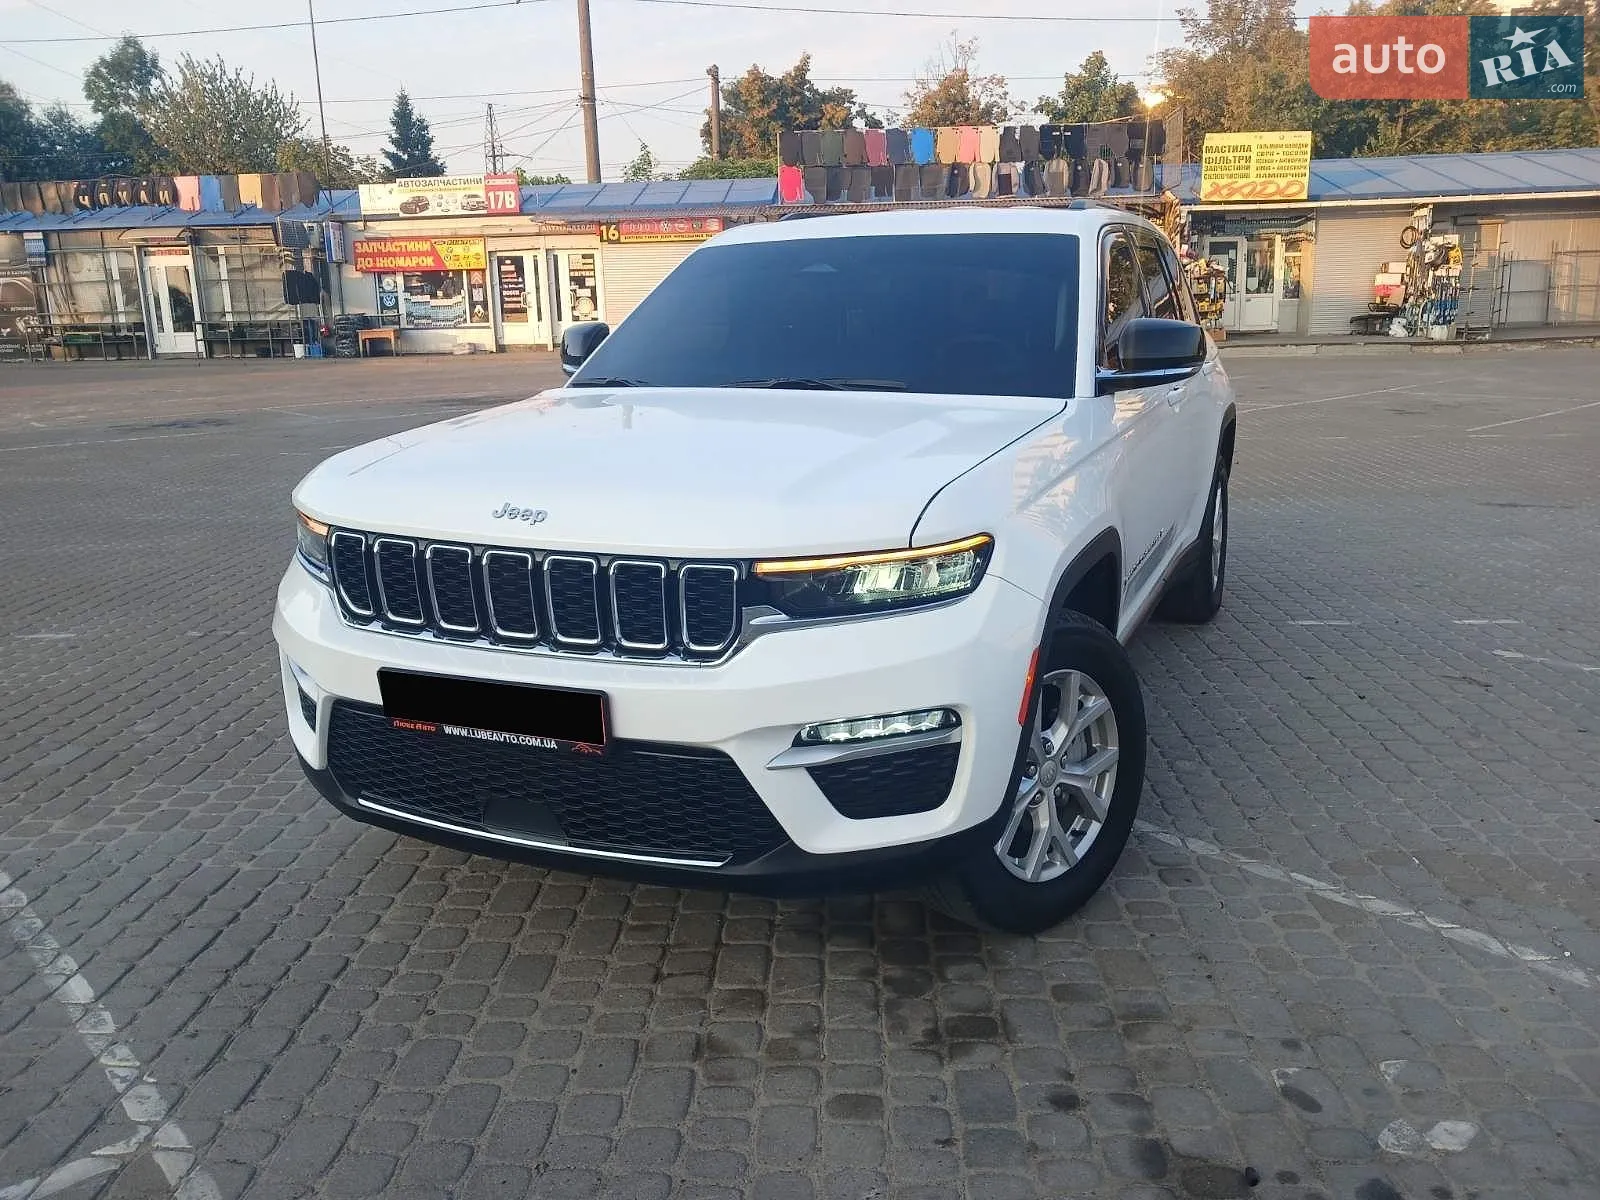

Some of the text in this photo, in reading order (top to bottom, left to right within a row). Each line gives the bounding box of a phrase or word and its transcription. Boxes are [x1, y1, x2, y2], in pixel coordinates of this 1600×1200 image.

[1205, 144, 1252, 154] МАСТИЛА
[1204, 155, 1252, 165] ФІЛЬТРИ
[398, 177, 483, 188] АВТОЗАПЧАСТИНИ
[601, 224, 619, 241] 16
[354, 240, 432, 253] ЗАПЧАСТИНИ
[356, 256, 434, 270] ДО ІНОМАРОК
[492, 502, 548, 525] Jeep
[443, 724, 558, 750] WWW.LUBEAVTO.COM.UA
